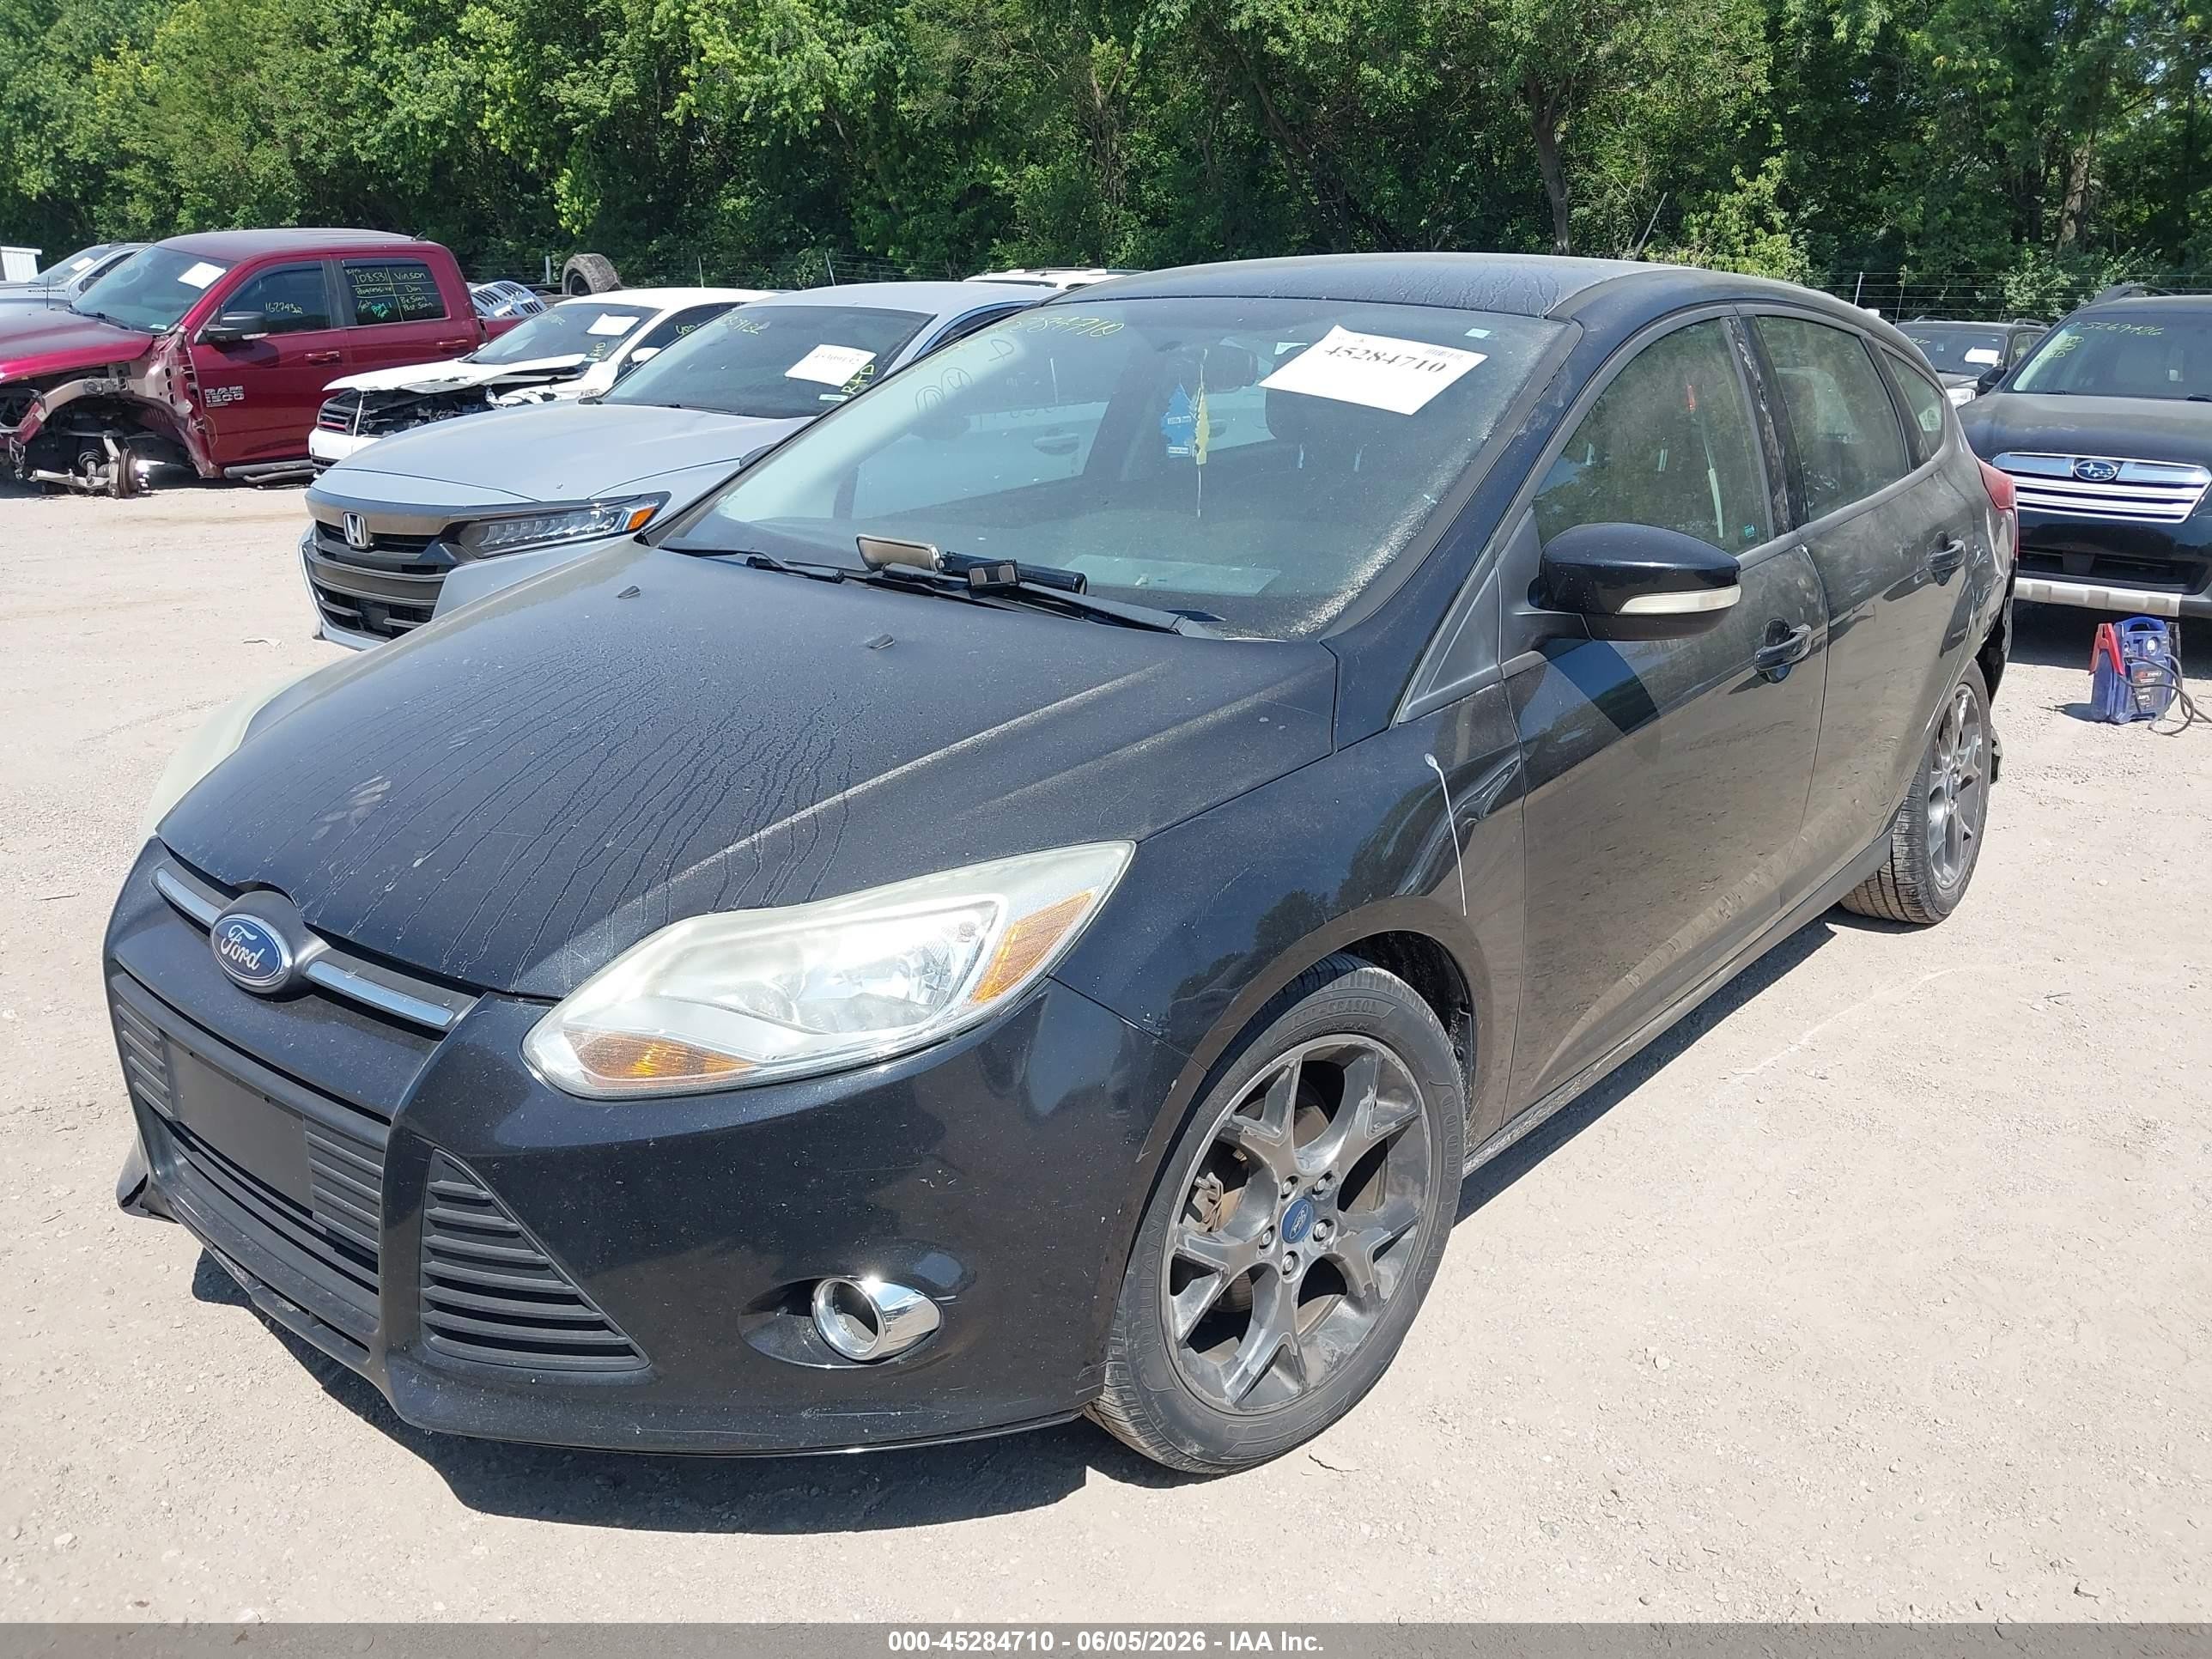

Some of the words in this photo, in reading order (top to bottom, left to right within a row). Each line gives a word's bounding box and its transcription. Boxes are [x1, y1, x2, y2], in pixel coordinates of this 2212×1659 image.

[1324, 346, 1447, 373] 45284710
[204, 386, 244, 396] RAM
[205, 393, 245, 404] 1500
[220, 924, 265, 970] Ford
